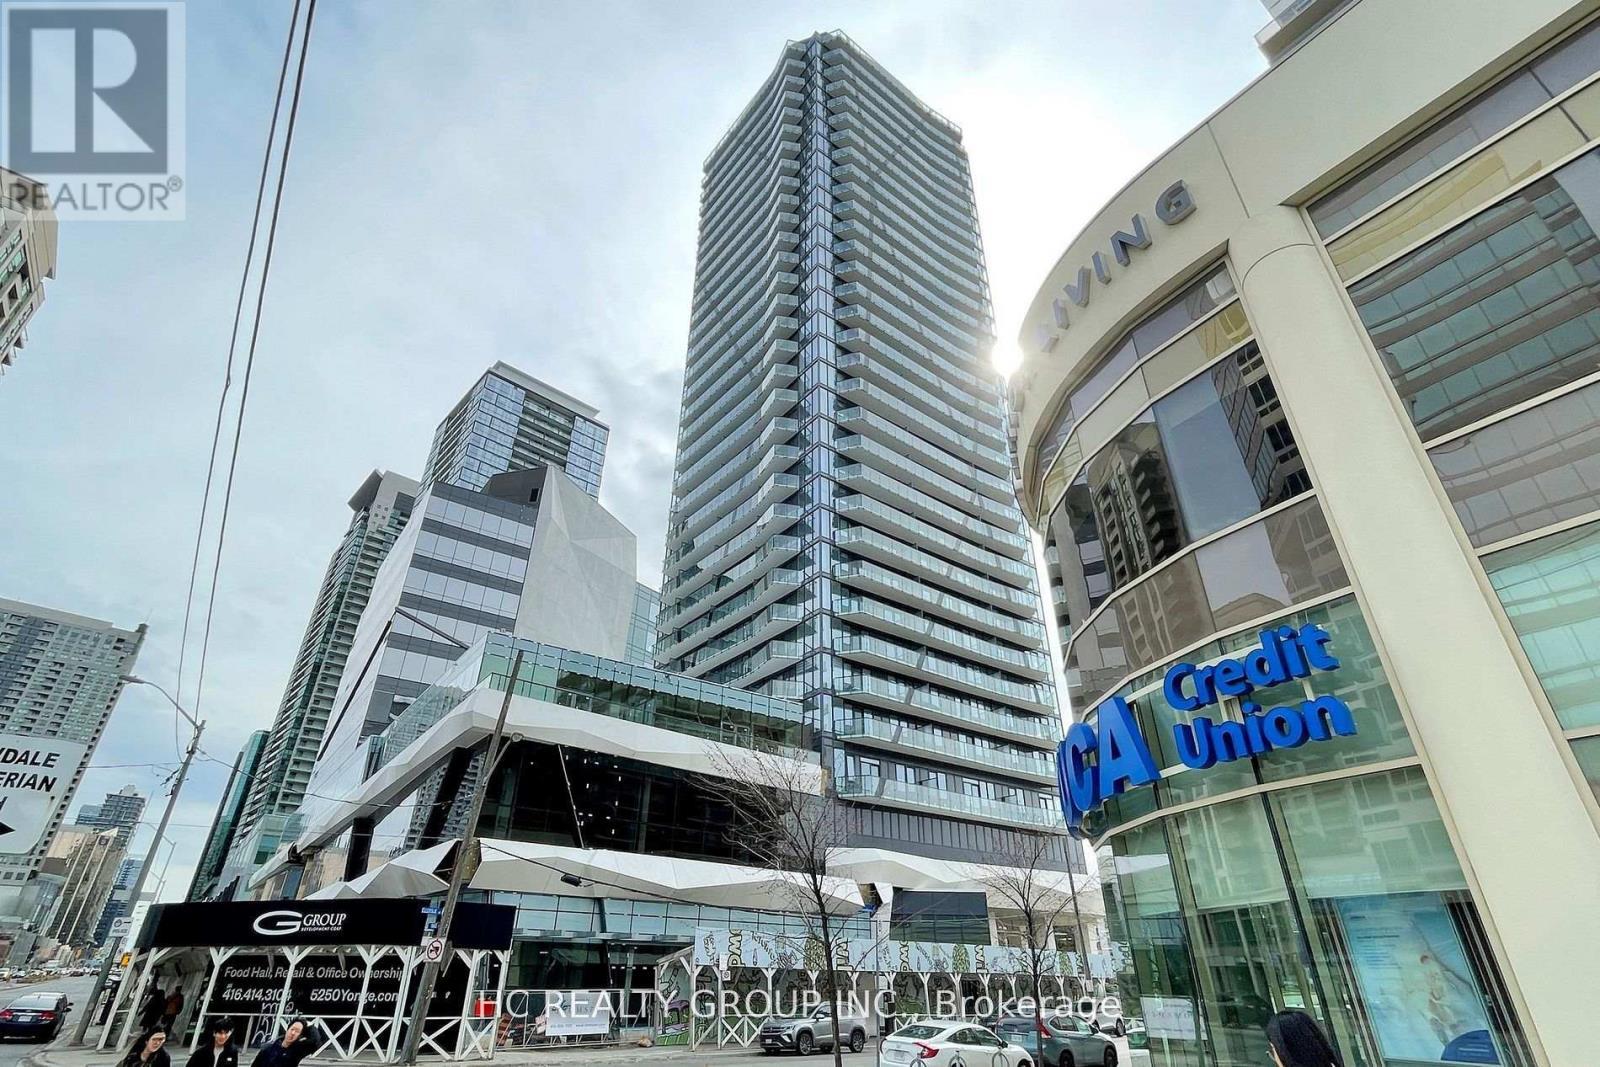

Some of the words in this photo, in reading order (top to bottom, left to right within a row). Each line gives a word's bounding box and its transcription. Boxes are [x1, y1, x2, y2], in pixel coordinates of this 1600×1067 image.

[1033, 178, 1198, 354] LIVING
[1163, 622, 1340, 711] Credit
[1173, 694, 1358, 769] Union
[303, 913, 347, 926] GROUP
[224, 966, 251, 978] Food
[274, 966, 306, 978] Reail
[305, 966, 315, 978] &
[316, 966, 348, 979] Office
